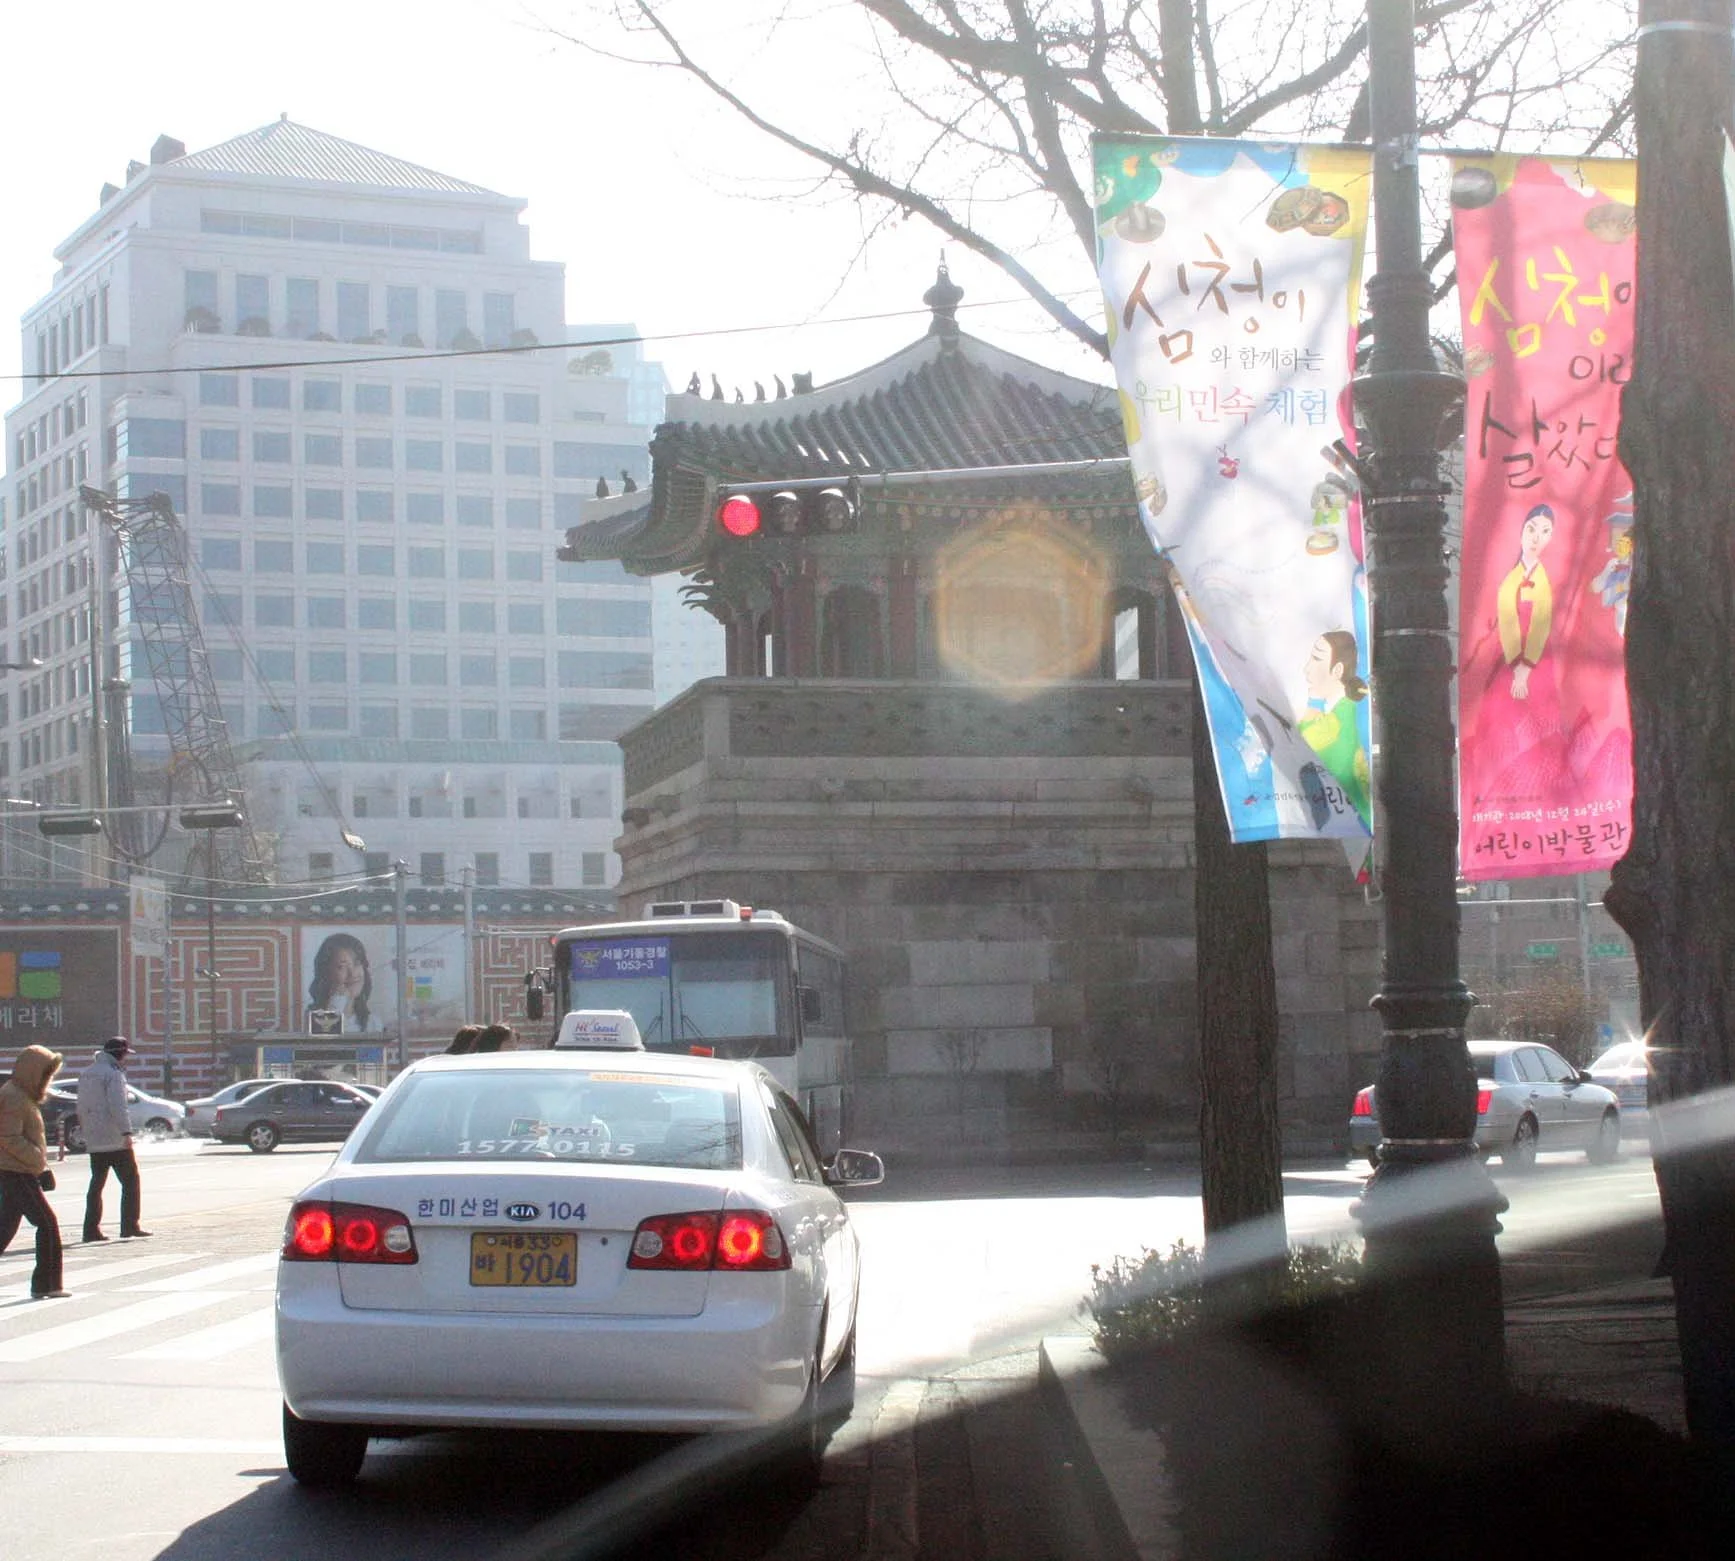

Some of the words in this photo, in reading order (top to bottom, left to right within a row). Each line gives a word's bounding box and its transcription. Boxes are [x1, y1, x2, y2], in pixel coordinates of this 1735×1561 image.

[1122, 232, 1305, 364] 심청이
[1238, 346, 1324, 373] 함께하는
[615, 959, 655, 971] 1053-3
[418, 1198, 499, 1217] 한미산업
[510, 1205, 536, 1218] KIA
[547, 1201, 587, 1221] 104
